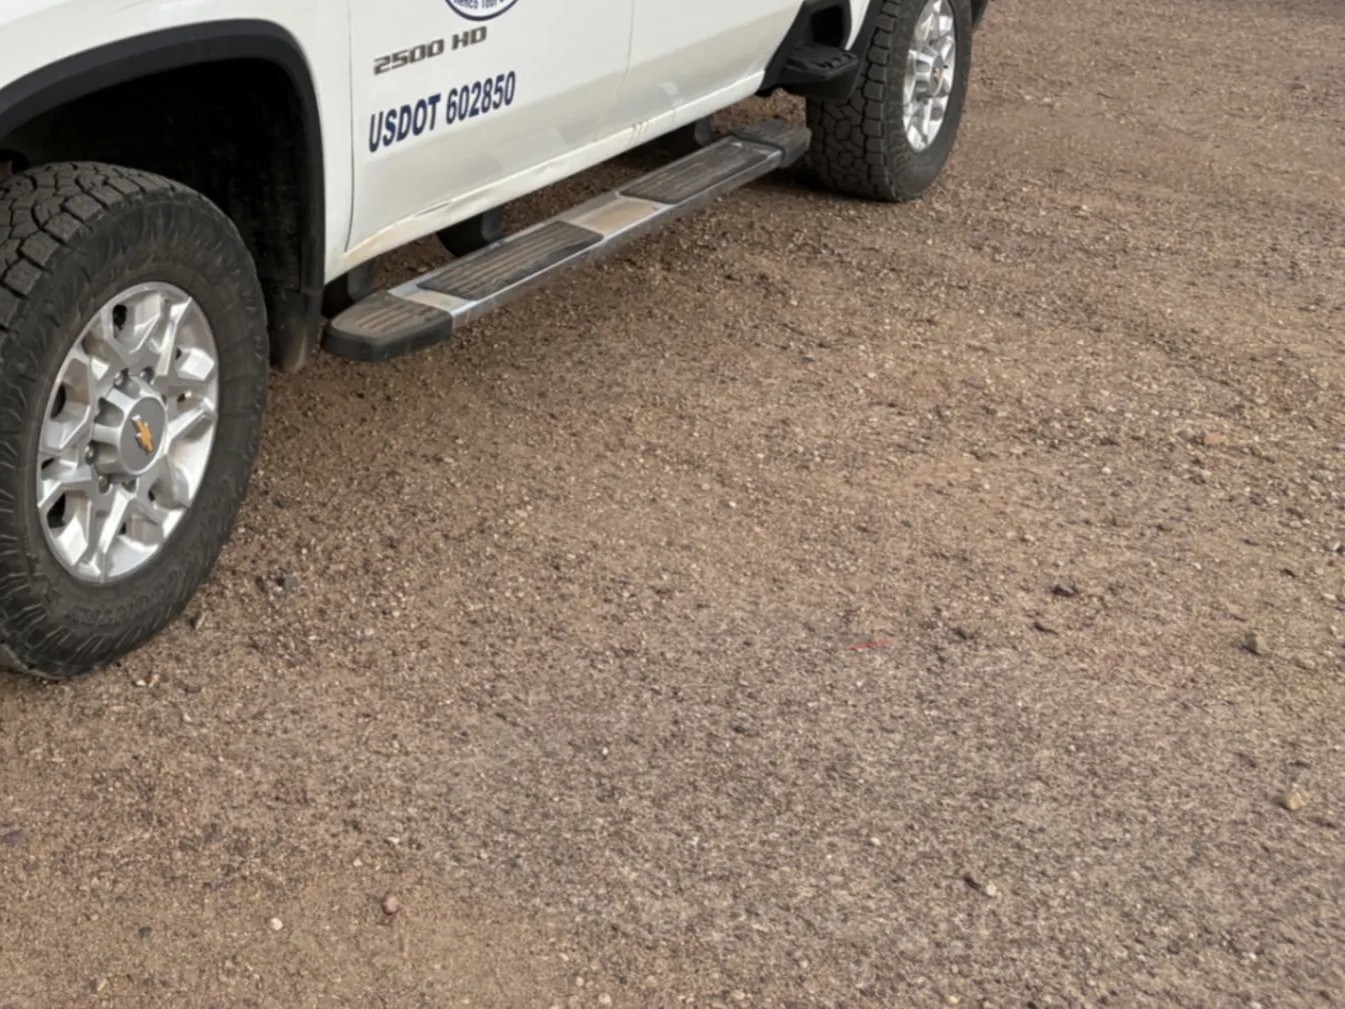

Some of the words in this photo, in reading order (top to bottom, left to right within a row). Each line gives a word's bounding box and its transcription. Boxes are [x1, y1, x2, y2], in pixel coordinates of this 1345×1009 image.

[374, 39, 444, 75] 2500
[452, 26, 487, 50] HD
[369, 93, 441, 153] USDOT
[446, 70, 515, 125] 602850
